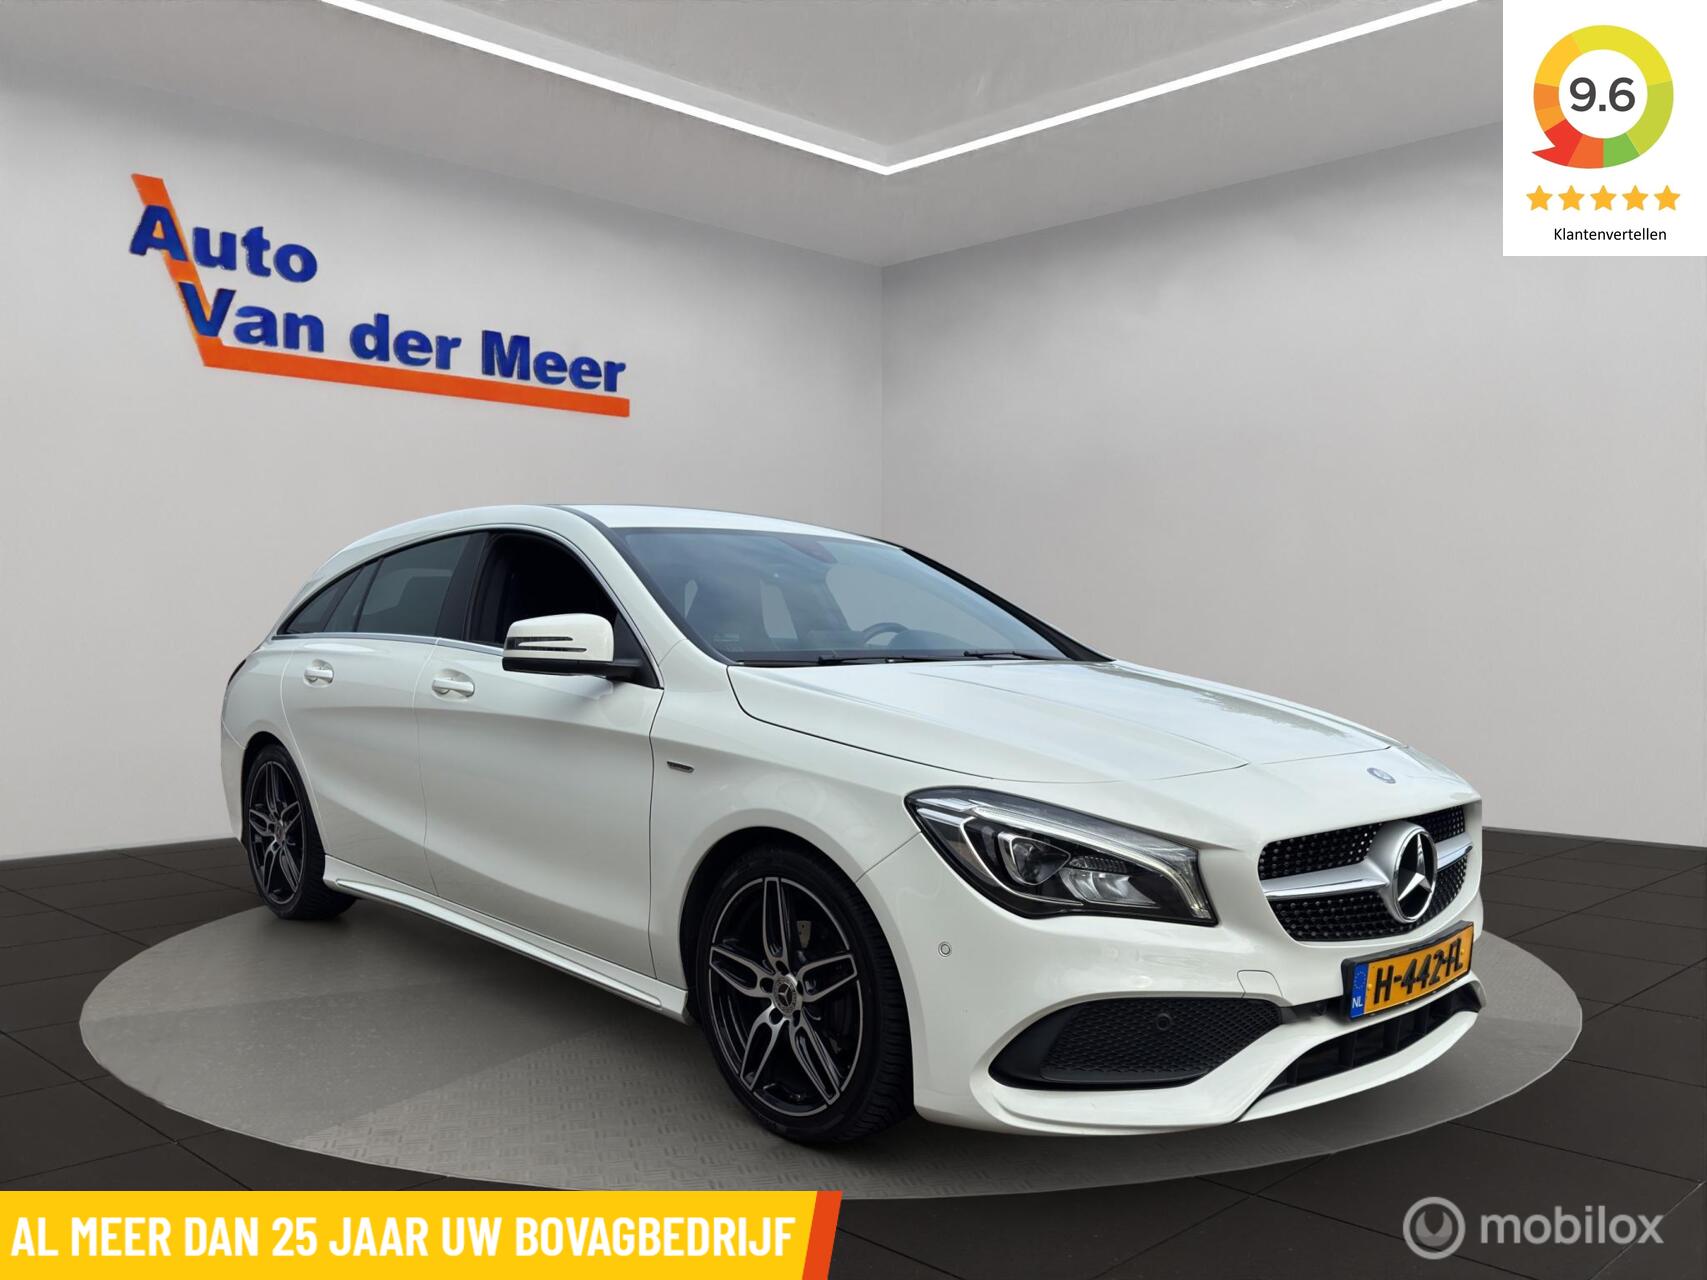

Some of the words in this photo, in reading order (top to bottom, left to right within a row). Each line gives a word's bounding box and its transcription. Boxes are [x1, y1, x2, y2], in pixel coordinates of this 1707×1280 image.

[129, 205, 318, 283] Auto
[180, 282, 325, 352] Van
[350, 313, 462, 370] der
[482, 330, 626, 392] Meer
[1352, 996, 1363, 1009] NL
